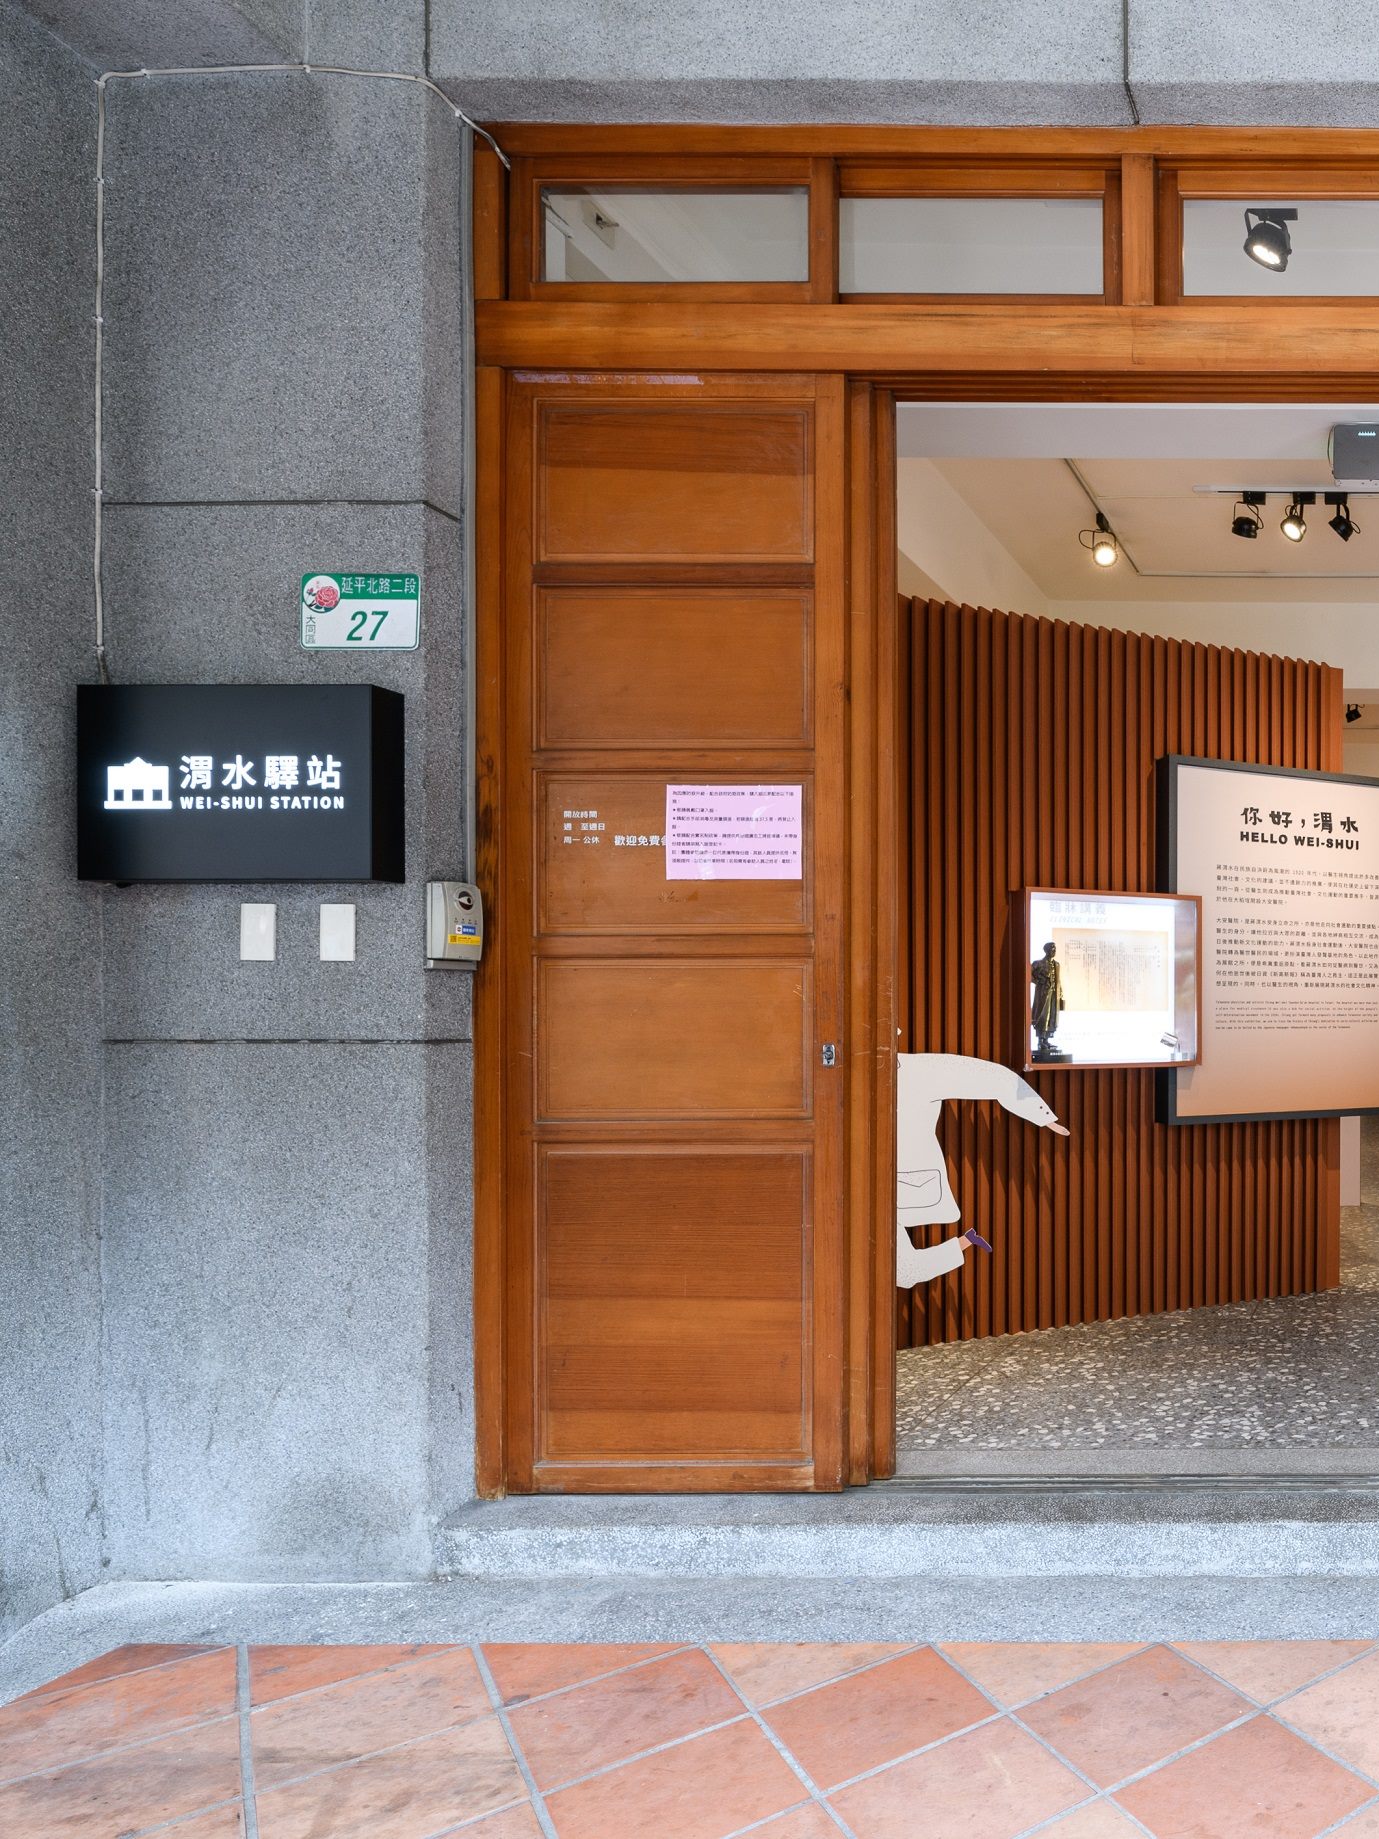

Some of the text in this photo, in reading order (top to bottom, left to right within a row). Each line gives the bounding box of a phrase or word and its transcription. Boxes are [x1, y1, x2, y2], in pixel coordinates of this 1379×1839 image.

[341, 577, 416, 594] 延平北路二段
[346, 611, 389, 641] 27
[179, 754, 342, 790] 渭水驛站
[180, 796, 344, 810] WEI-SHUI STATION
[1240, 831, 1359, 850] HELLO WEI-SHUI
